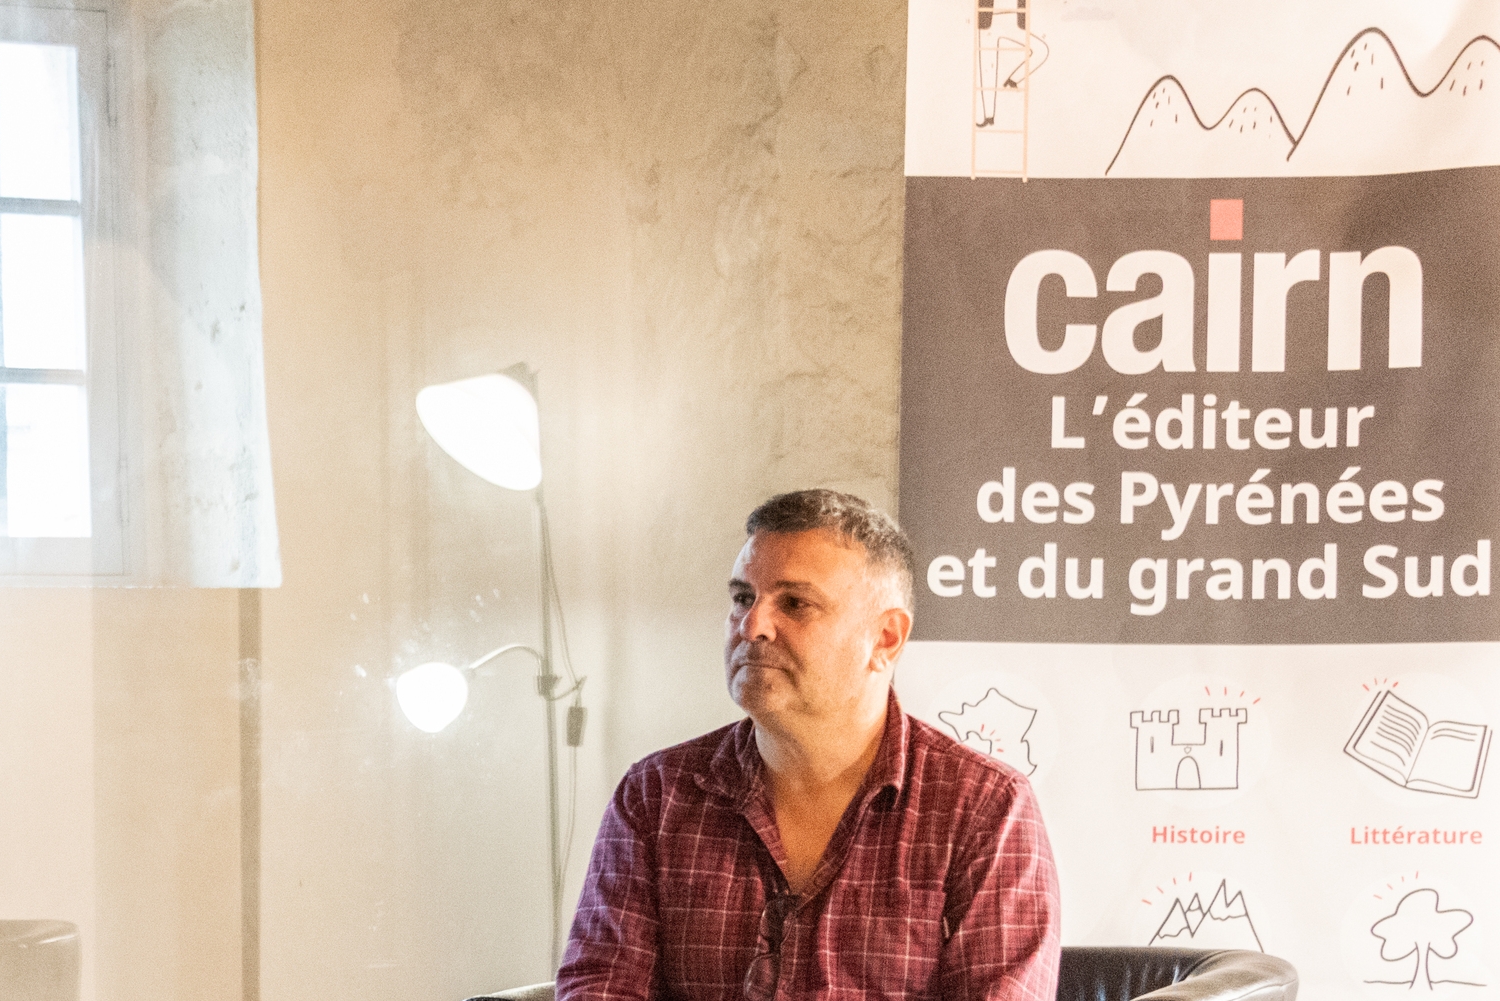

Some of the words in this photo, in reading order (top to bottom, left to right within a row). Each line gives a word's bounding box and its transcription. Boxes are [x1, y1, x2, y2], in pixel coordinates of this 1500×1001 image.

[1004, 199, 1423, 375] cairn
[976, 467, 1095, 524] des
[1120, 466, 1446, 540] Pyrénées
[927, 548, 997, 597] et
[1018, 542, 1104, 598] du
[1128, 543, 1337, 616] grand
[1361, 539, 1492, 597] Sud
[1151, 825, 1246, 845] Histoire
[1350, 825, 1483, 845] Littérature
